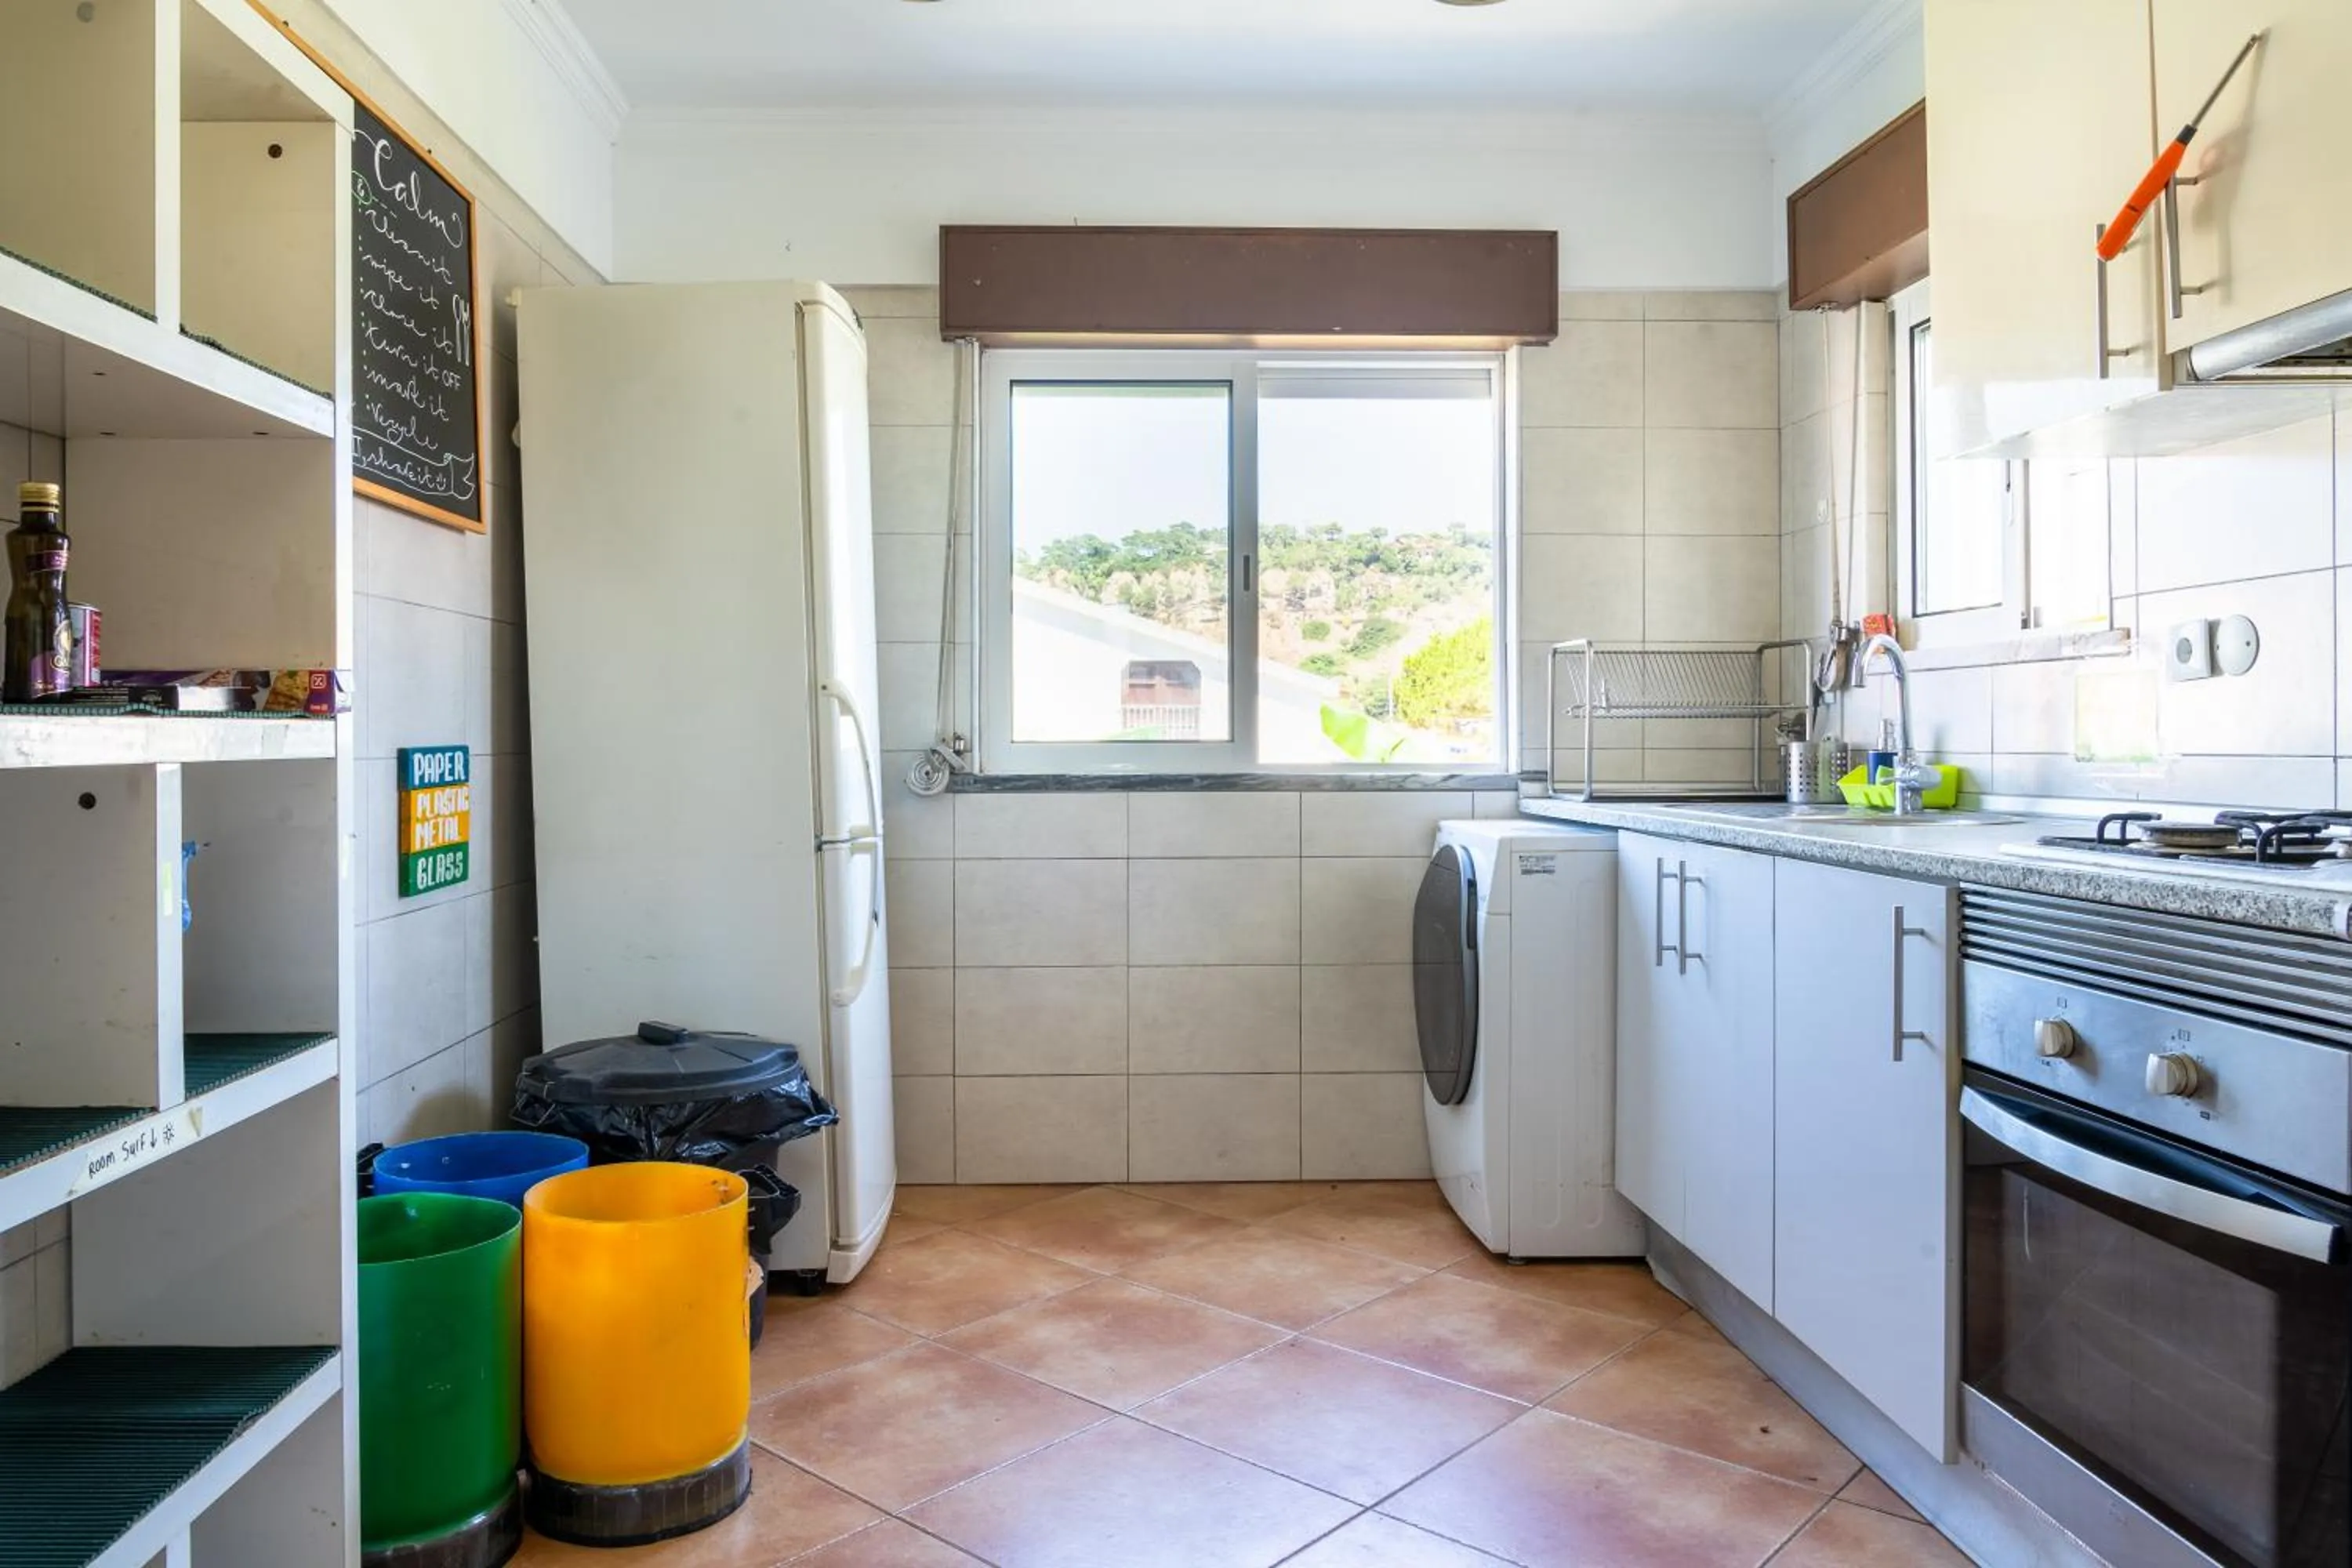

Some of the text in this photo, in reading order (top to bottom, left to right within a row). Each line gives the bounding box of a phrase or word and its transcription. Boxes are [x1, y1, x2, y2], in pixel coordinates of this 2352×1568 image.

[367, 133, 463, 248] Calm
[362, 254, 440, 310] wipe it
[365, 321, 462, 390] turn it OFF
[432, 326, 454, 354] it
[429, 394, 450, 422] it
[413, 750, 466, 786] PAPER
[416, 786, 470, 819] PLASTIC
[415, 815, 460, 851] METAL
[417, 851, 464, 891] GLASS
[122, 1132, 146, 1161] Surf
